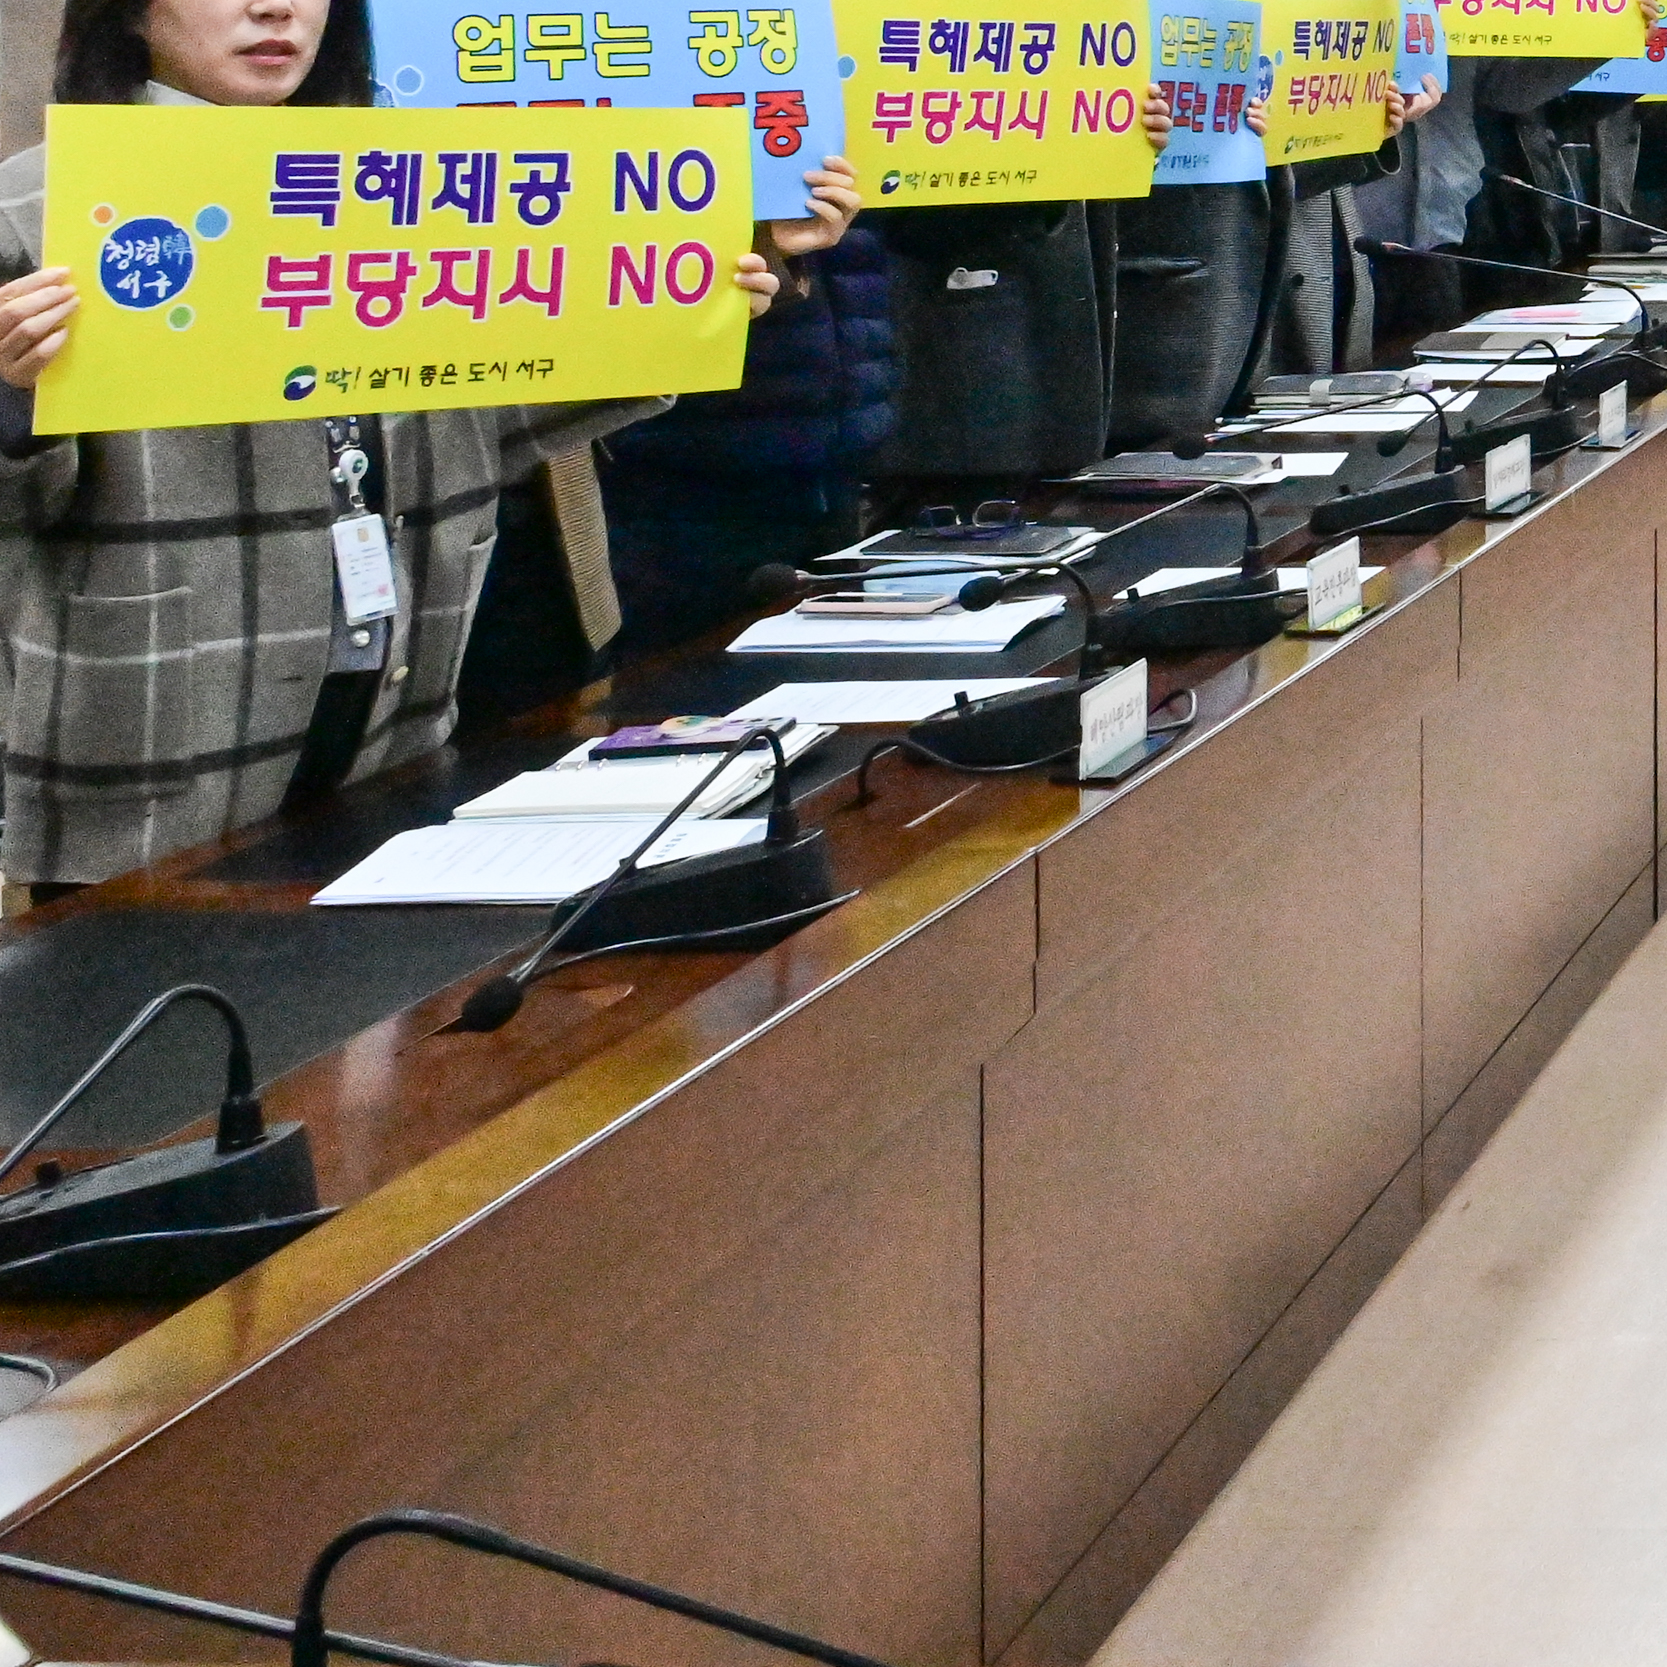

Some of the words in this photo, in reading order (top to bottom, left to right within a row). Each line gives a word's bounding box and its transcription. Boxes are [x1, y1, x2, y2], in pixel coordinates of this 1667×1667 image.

[453, 11, 652, 84] 업무는
[687, 8, 798, 78] 공정
[878, 17, 1057, 76] 특혜제공
[1080, 18, 1137, 67] NO
[1160, 14, 1218, 68] 업무는
[1292, 19, 1370, 61] 특혜제공
[1373, 19, 1395, 53] NO
[871, 89, 1047, 144] 부당지시
[1072, 87, 1136, 134] NO
[1287, 73, 1358, 116] 부당지시
[1361, 69, 1388, 104] NO
[269, 148, 572, 226] 특혜제공
[613, 146, 718, 215] NO
[117, 269, 173, 299] 서구
[260, 245, 565, 329] 부당지시
[607, 239, 716, 308] NO
[325, 366, 362, 394] 딱!
[368, 365, 411, 390] 살기
[419, 363, 458, 387] 좋은
[467, 361, 508, 383] 도시
[515, 358, 555, 381] 서구
